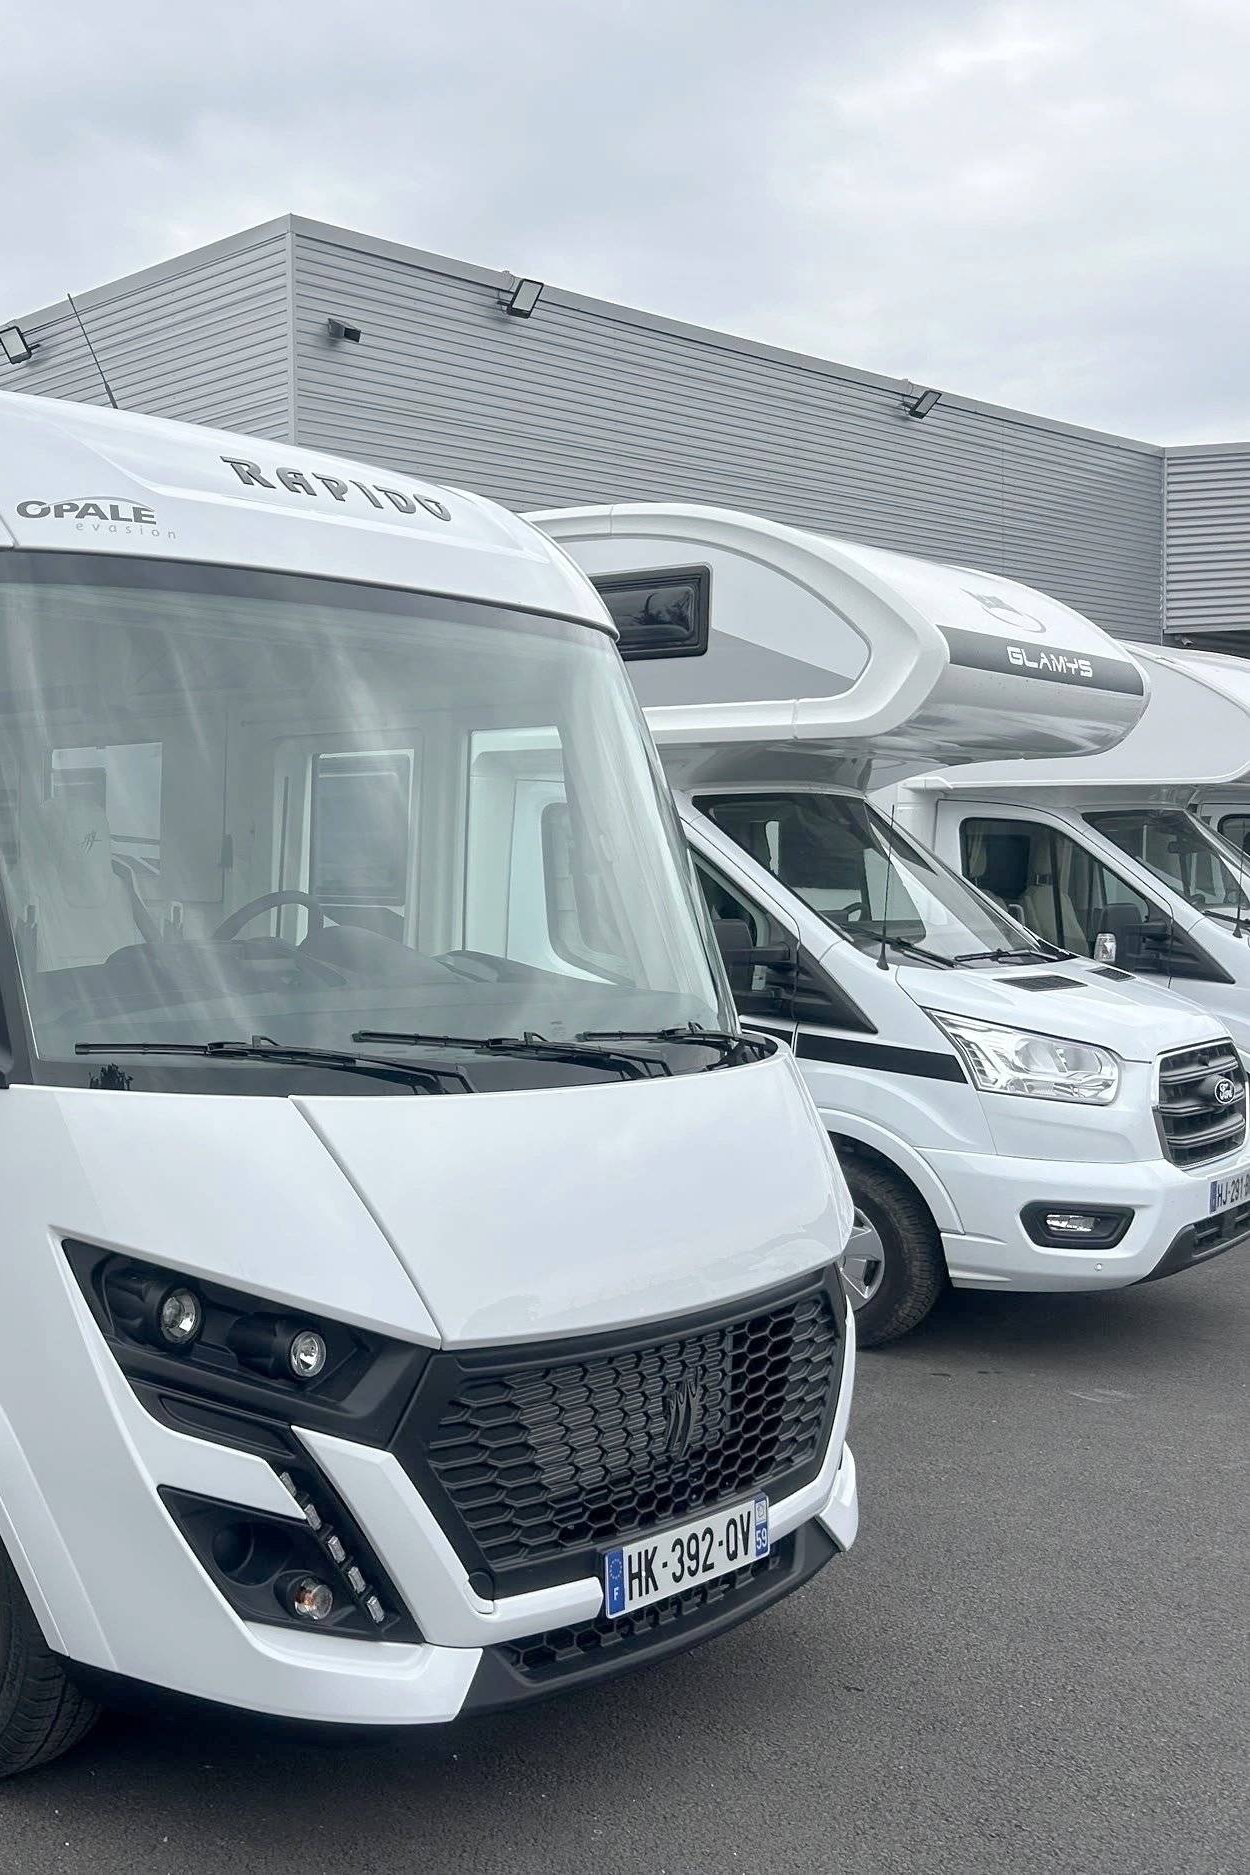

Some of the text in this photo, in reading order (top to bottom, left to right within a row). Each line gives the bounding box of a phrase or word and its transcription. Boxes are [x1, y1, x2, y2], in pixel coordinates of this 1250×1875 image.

[219, 455, 452, 522] RAPIDO
[16, 500, 157, 525] OPALE
[75, 522, 177, 540] evasion
[613, 1510, 768, 1601] F HK-392-QV 59
